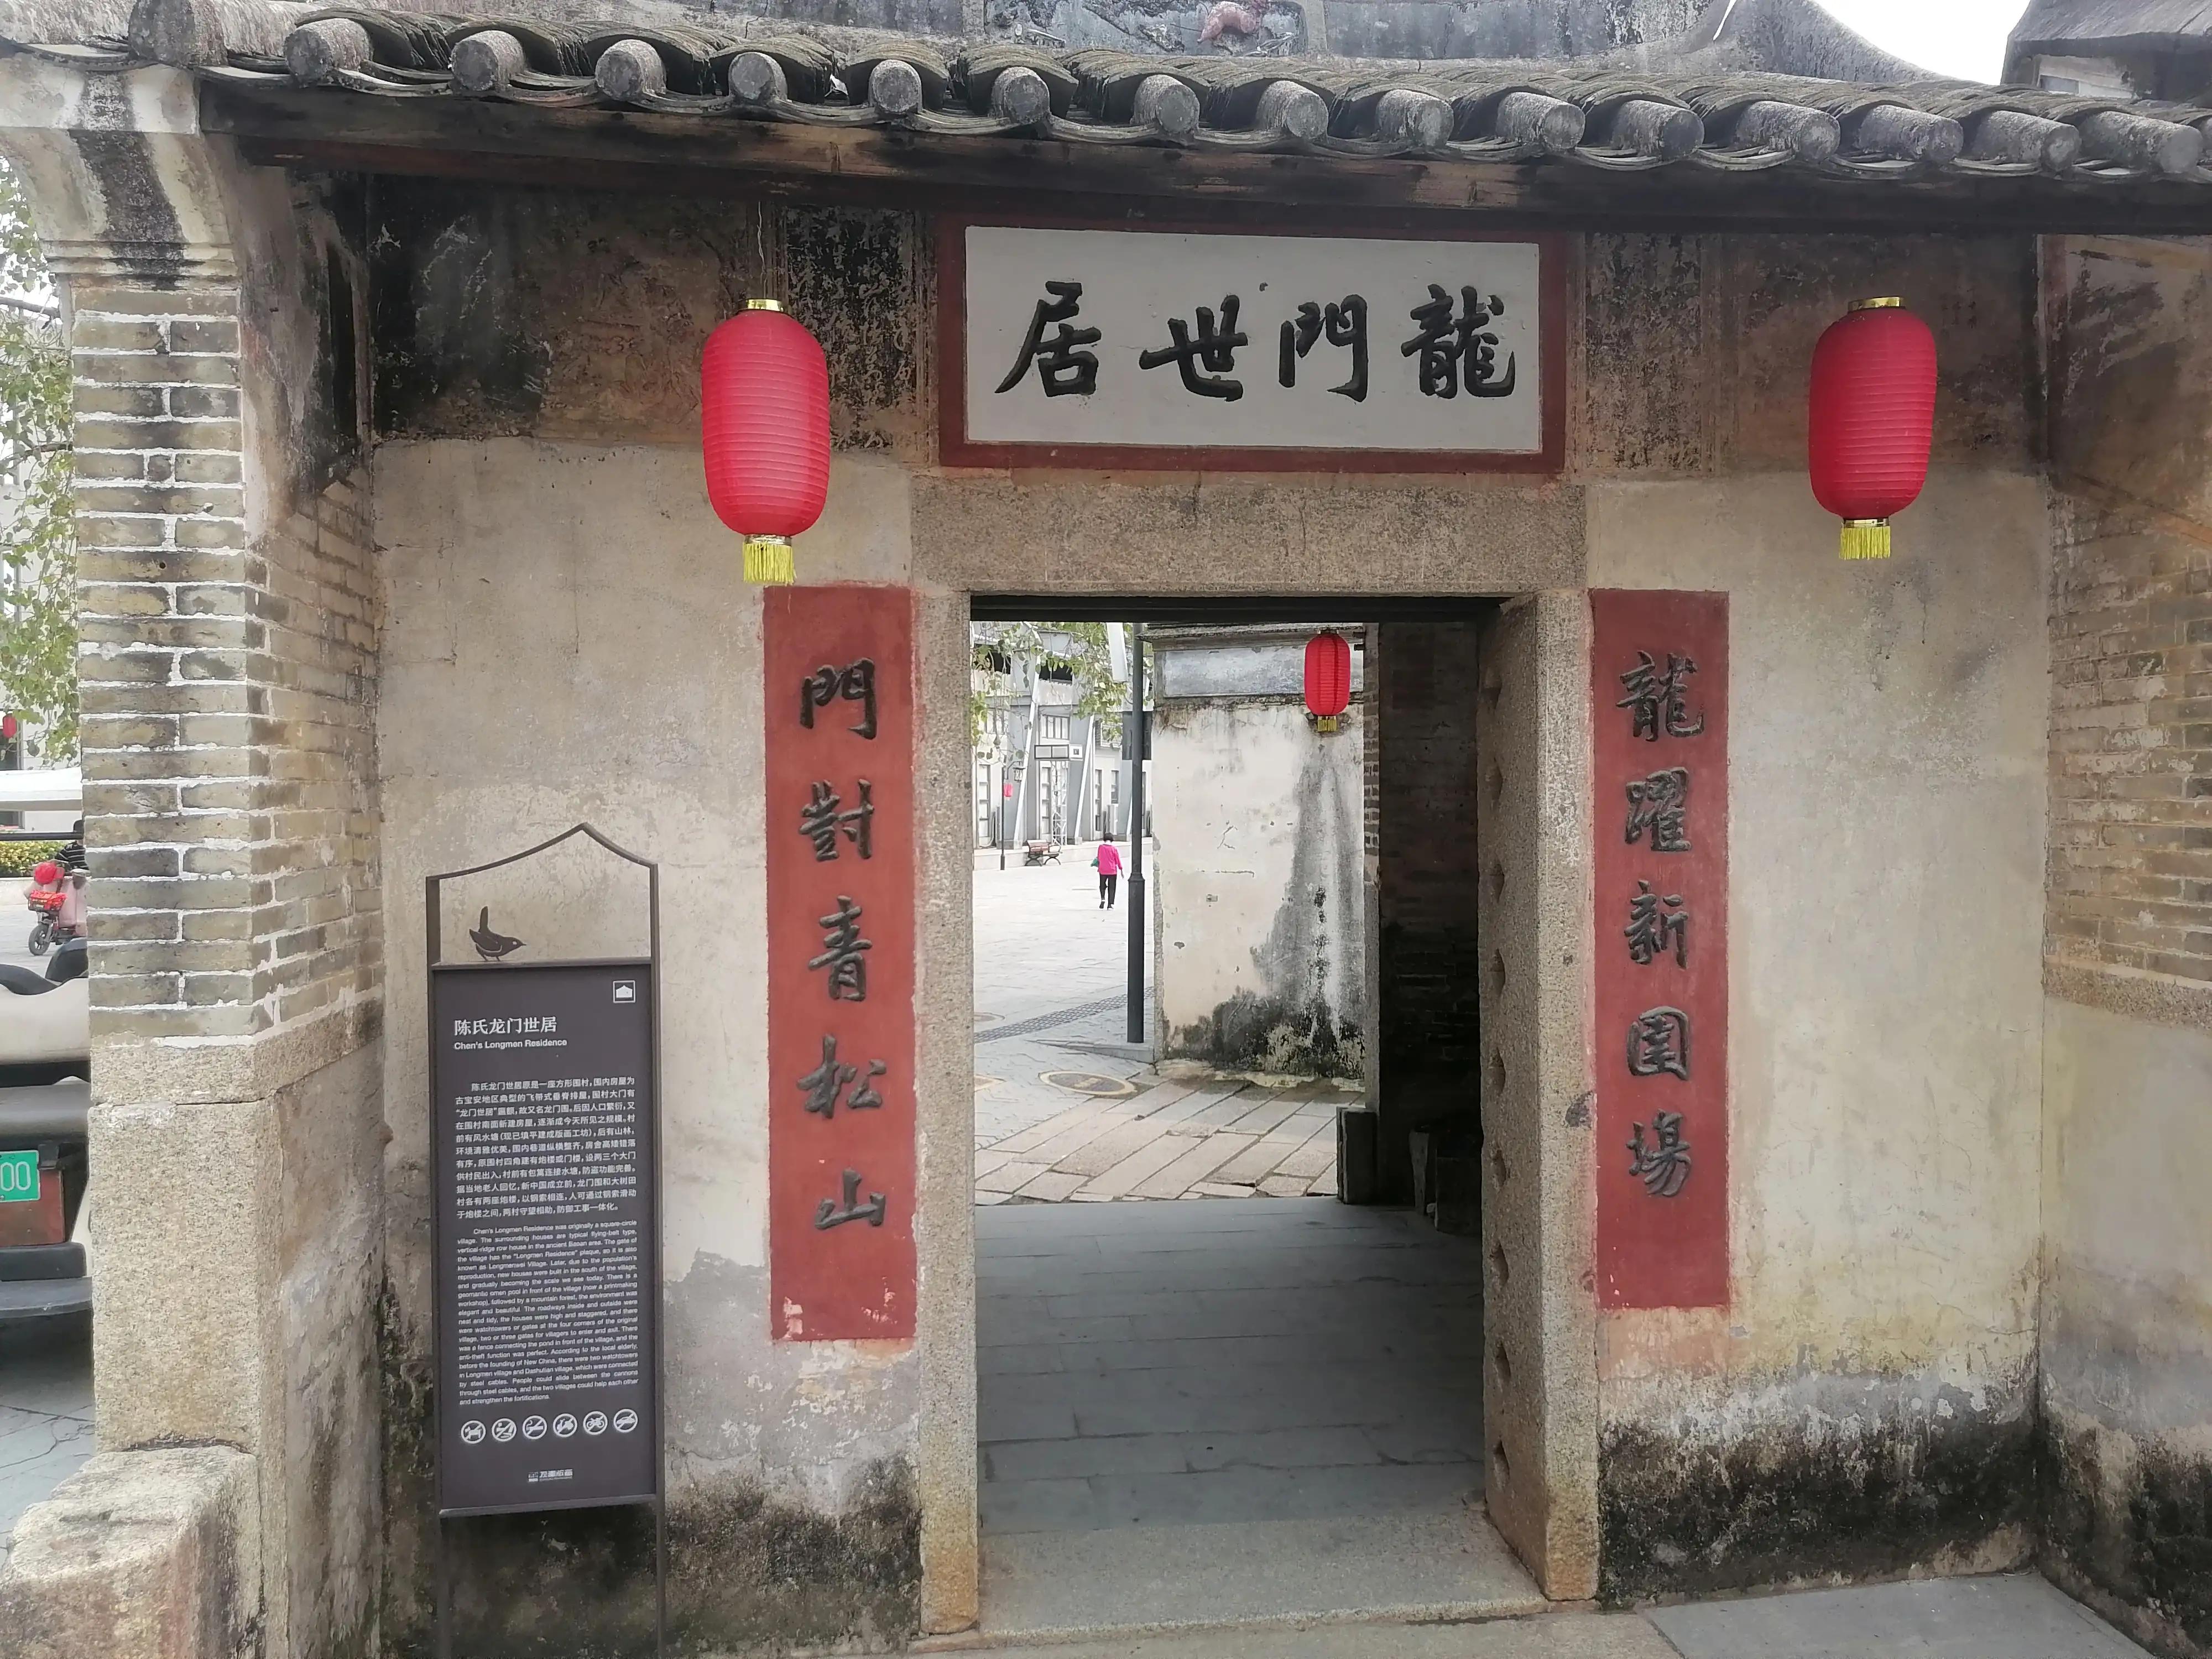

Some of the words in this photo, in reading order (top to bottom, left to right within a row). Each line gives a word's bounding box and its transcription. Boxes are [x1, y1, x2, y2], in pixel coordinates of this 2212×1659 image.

[454, 1016, 557, 1036] 陈氏龙门世居
[454, 1041, 483, 1050] Chen's
[485, 1041, 523, 1050] Longmen
[525, 1039, 567, 1047] Residence
[495, 1226, 522, 1234] Longmen
[495, 1235, 529, 1243] surrounding
[602, 1255, 637, 1264] population's
[500, 1279, 529, 1287] becoming
[604, 1281, 637, 1290] printmaking
[538, 1303, 565, 1312] roadways
[545, 1330, 568, 1338] villagers
[551, 1347, 580, 1355] According
[490, 1360, 515, 1368] founding
[466, 1370, 492, 1379] Longmen
[460, 1389, 481, 1397] through
[472, 1397, 502, 1405] strengthen
